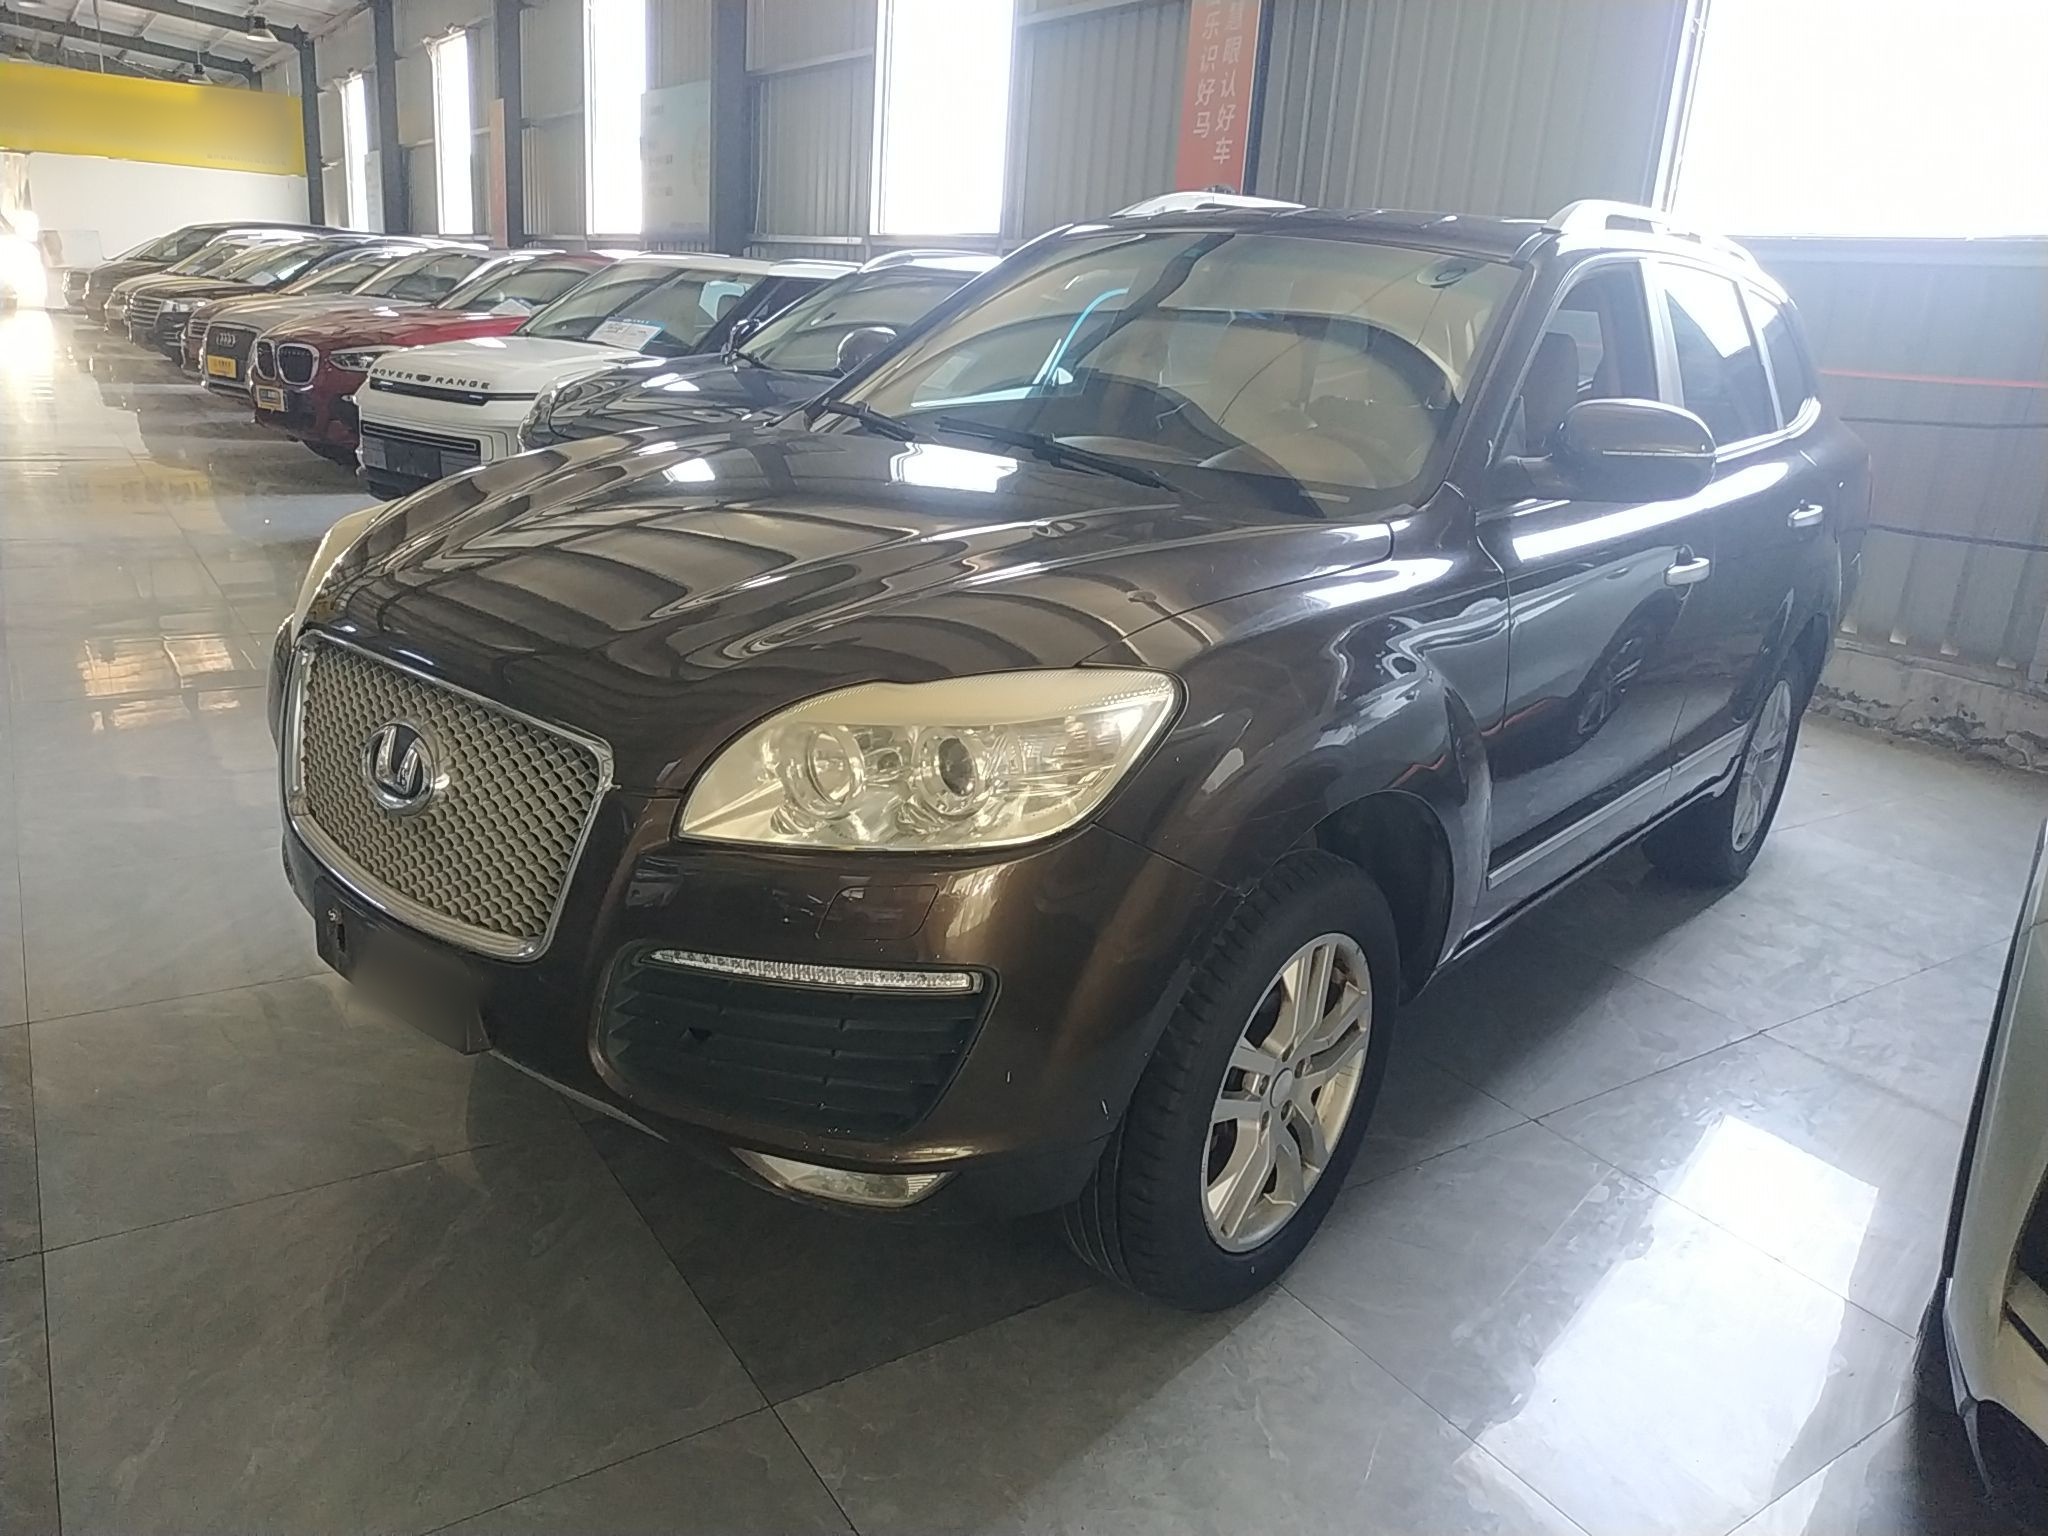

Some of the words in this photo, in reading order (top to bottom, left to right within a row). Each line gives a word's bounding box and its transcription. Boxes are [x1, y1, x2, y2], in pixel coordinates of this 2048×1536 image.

[1193, 0, 1219, 139] 乐识好马
[371, 368, 413, 380] ROVER
[435, 376, 491, 390] RANGE
